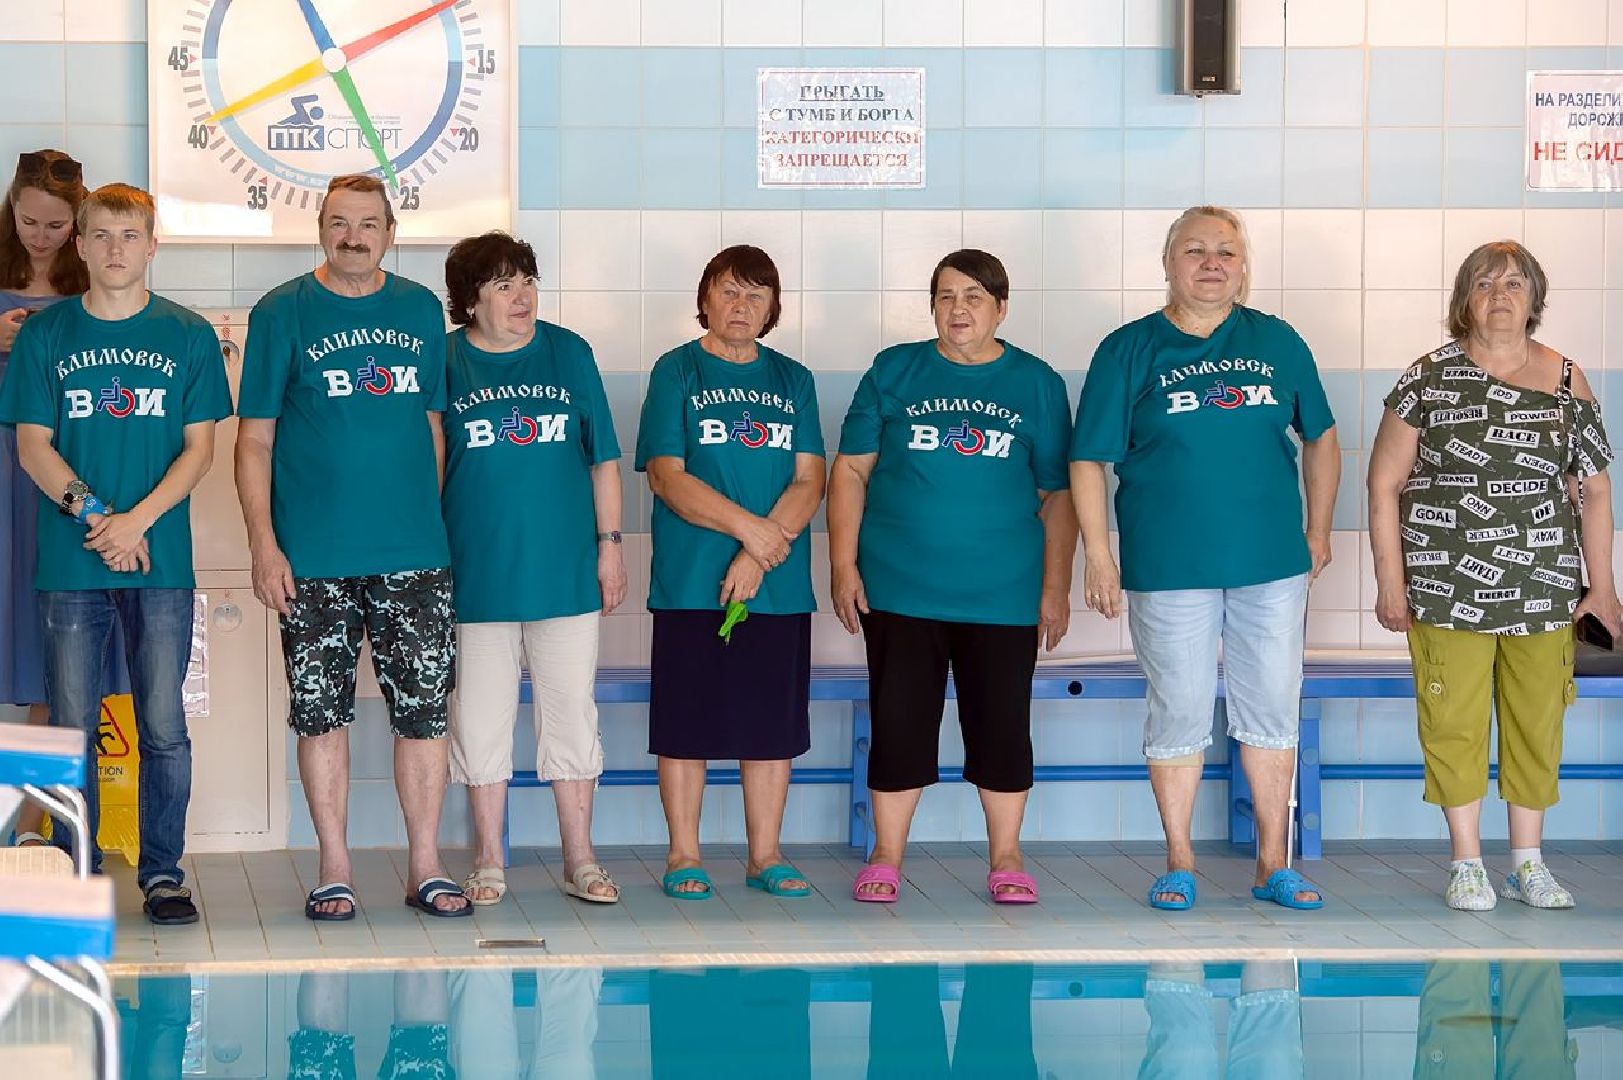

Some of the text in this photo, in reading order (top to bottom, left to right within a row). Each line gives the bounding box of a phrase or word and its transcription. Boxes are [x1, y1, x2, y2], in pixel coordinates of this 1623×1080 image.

[168, 46, 189, 71] 45
[477, 50, 496, 75] 15
[800, 85, 884, 98] ПРЫГАТЬ
[1535, 92, 1554, 107] НА
[769, 109, 915, 121] С ТУМБ И БОРТА
[188, 125, 207, 149] 40
[270, 127, 322, 149] ПТК
[459, 127, 479, 152] 20
[765, 130, 920, 144] КАТЕГОРИЧЕСКИ
[777, 153, 908, 168] ЗАПРЕЩАЕТСЯ
[1534, 141, 1568, 161] НЕ
[248, 186, 268, 211] 35
[400, 186, 420, 211] 25
[306, 327, 424, 362] КЛИМОВСК
[55, 348, 177, 380] КЛИМОВСК
[452, 384, 570, 414] КЛИМОВСК
[690, 388, 795, 414] КЛИМОВСК
[905, 398, 1023, 429] КЛИМОВСК
[1510, 411, 1557, 422] POWER
[1491, 429, 1537, 443] RACE
[1449, 441, 1489, 463] STEADY
[1521, 456, 1555, 472] OPEN
[1490, 481, 1547, 494] DECIDE
[1415, 508, 1452, 523] GOAL
[1535, 504, 1552, 520] OF
[1533, 531, 1557, 542] WAY
[1462, 559, 1499, 582] START
[98, 765, 123, 776] TION
